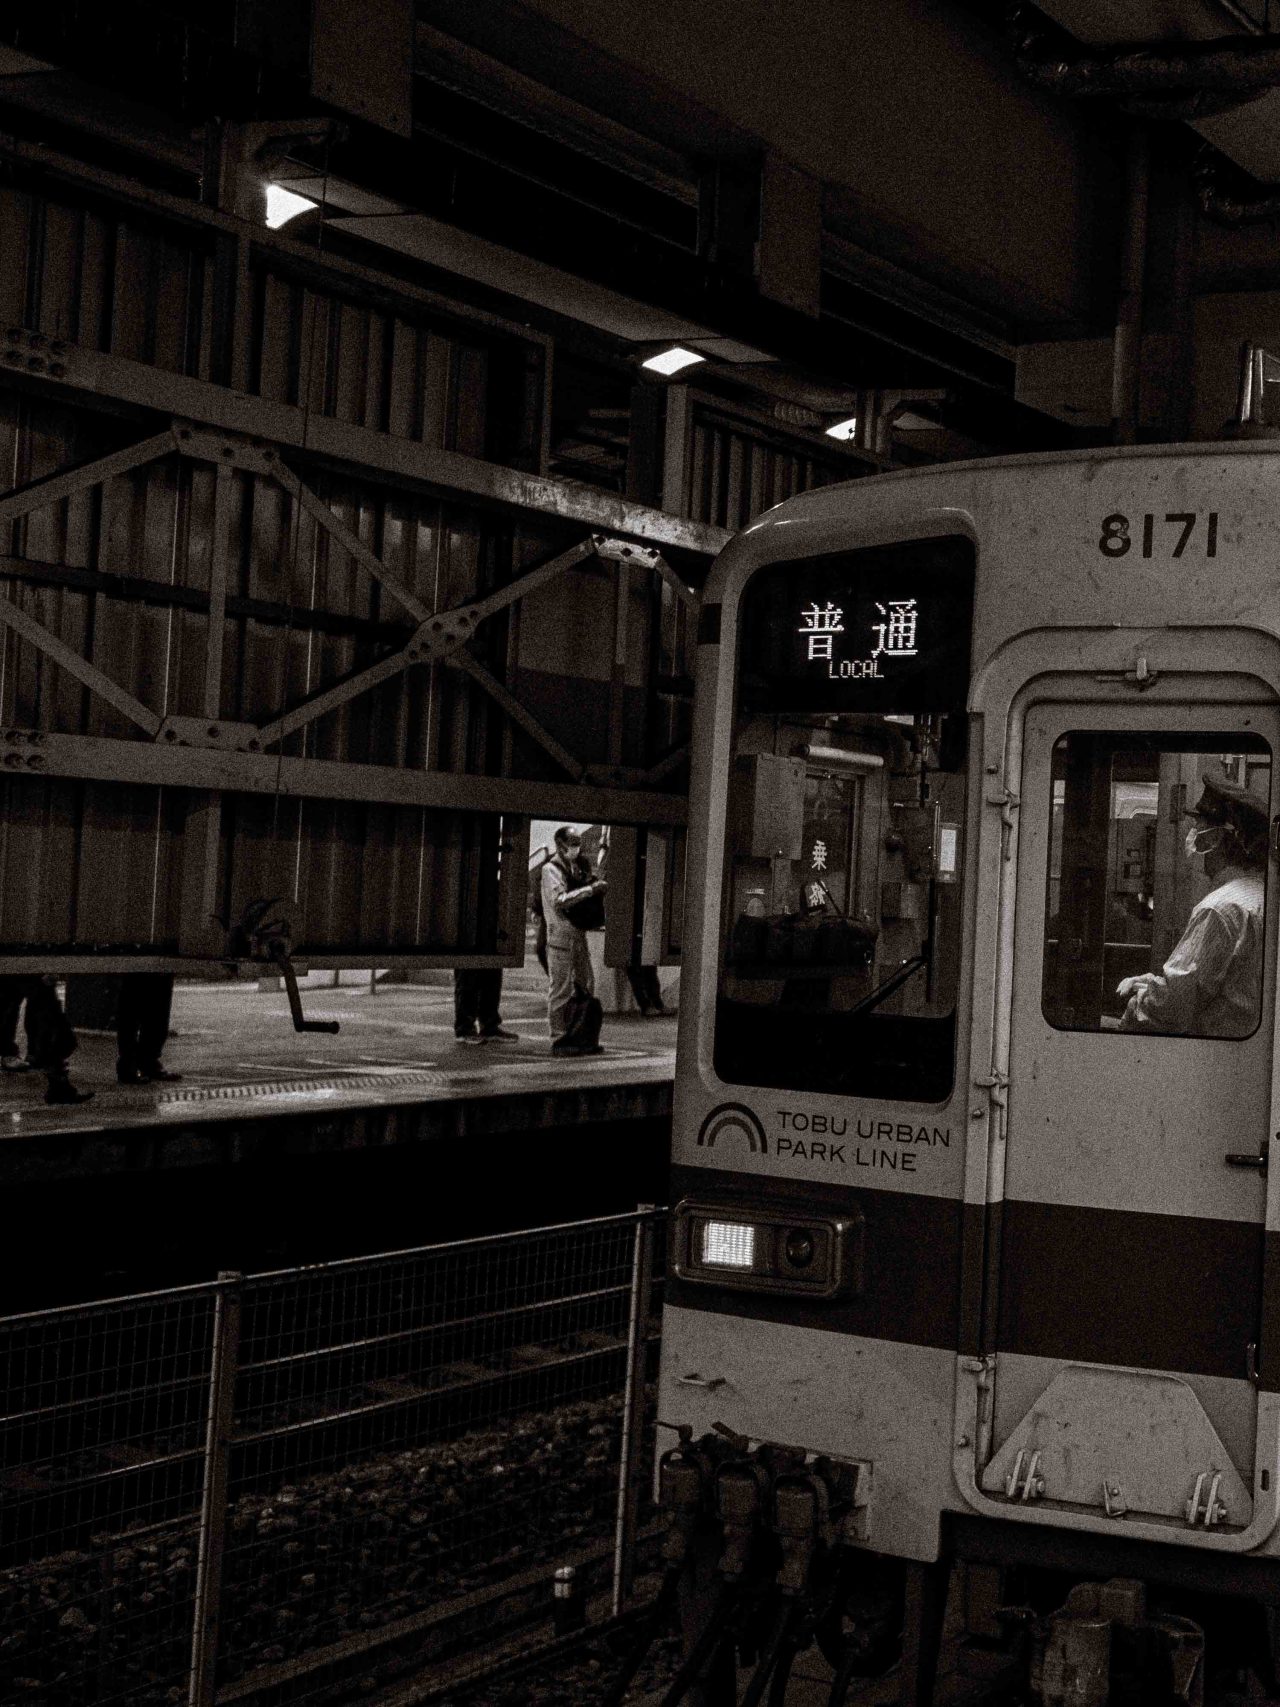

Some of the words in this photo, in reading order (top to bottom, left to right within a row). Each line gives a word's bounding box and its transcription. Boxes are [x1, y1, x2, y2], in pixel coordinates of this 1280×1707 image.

[1098, 512, 1219, 558] 8171
[798, 598, 920, 661] 普通
[828, 659, 885, 679] LOCAL
[776, 1110, 848, 1137] TOBU
[856, 1119, 950, 1148] URBAN
[775, 1138, 847, 1165] PARK
[856, 1148, 917, 1173] LINE
